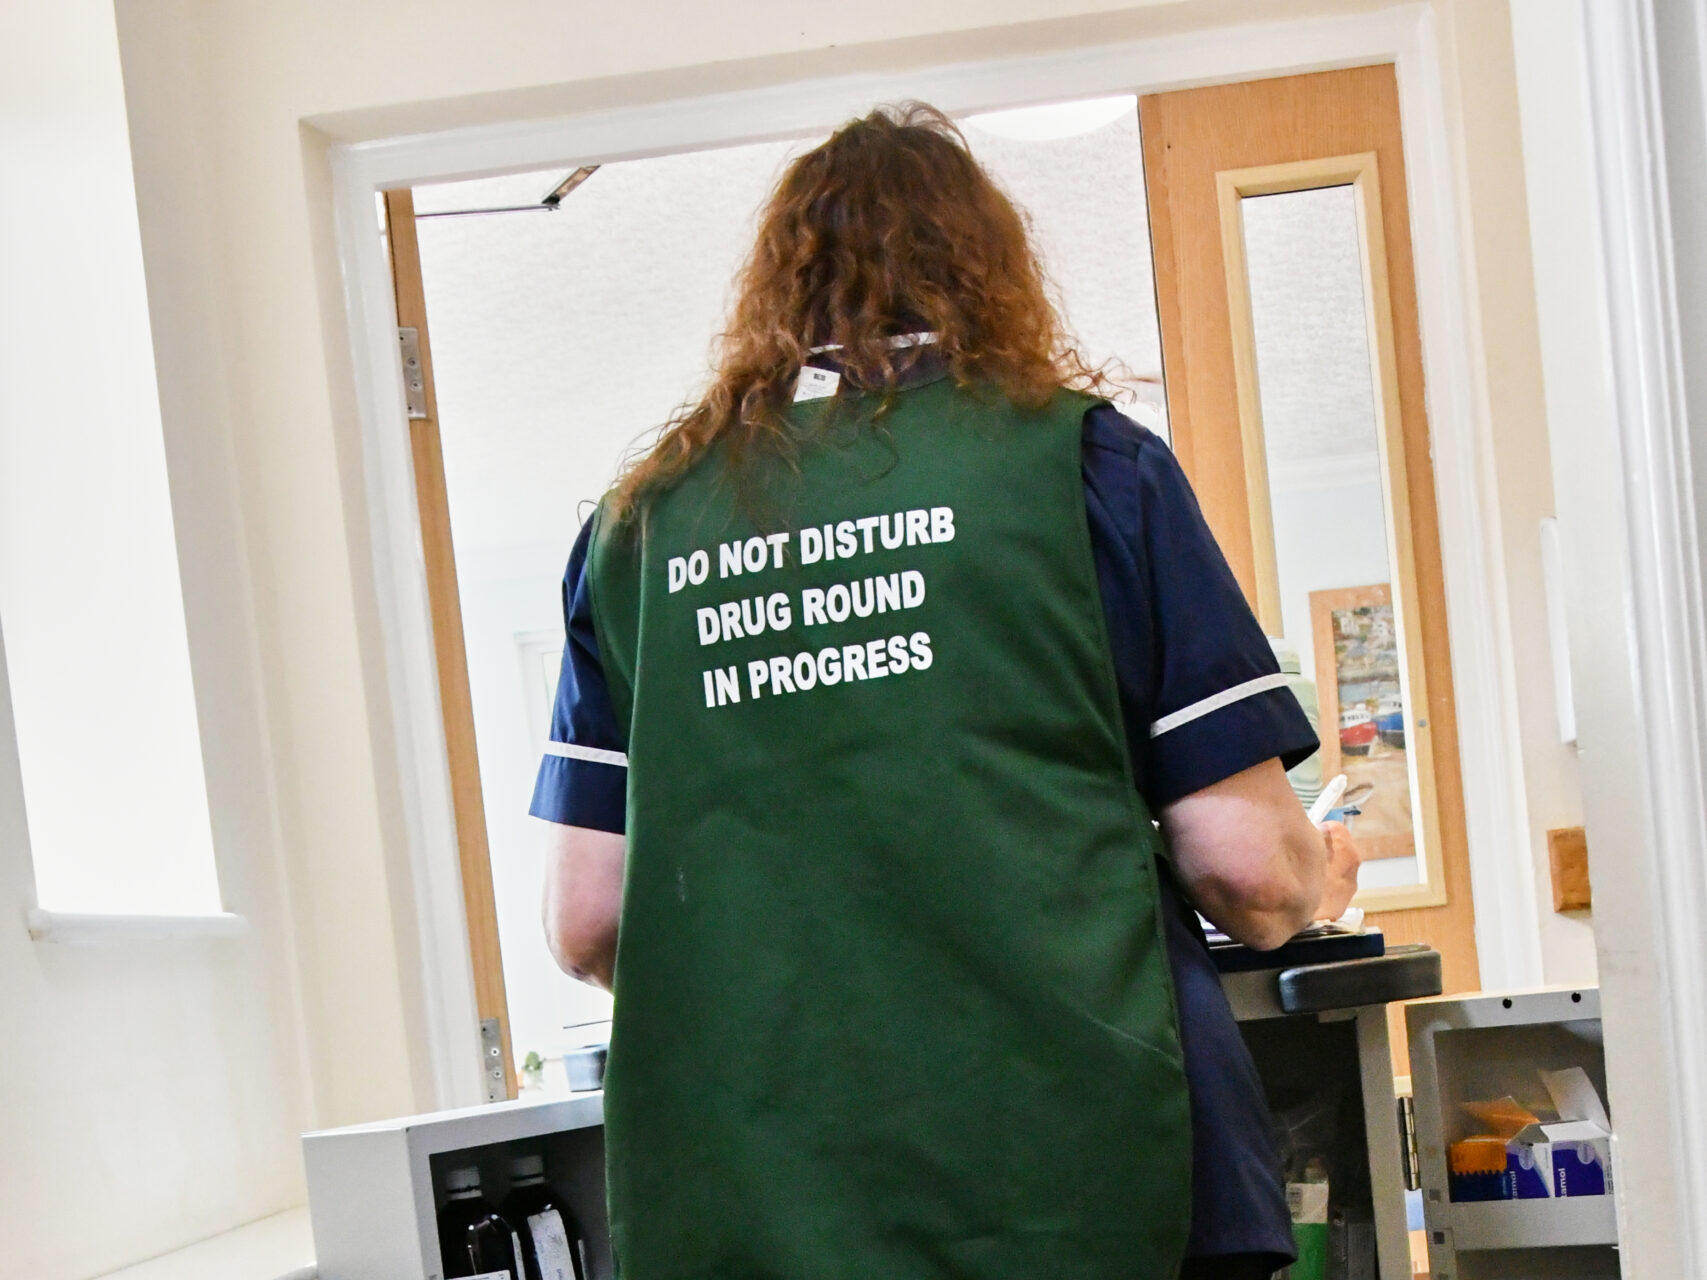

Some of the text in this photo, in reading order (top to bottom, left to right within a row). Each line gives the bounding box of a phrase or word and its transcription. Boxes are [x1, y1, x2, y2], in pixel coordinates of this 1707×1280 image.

[668, 507, 956, 593] DO NOT DISTURB
[697, 571, 926, 645] DRUG ROUND
[703, 632, 933, 708] IN PROGRESS
